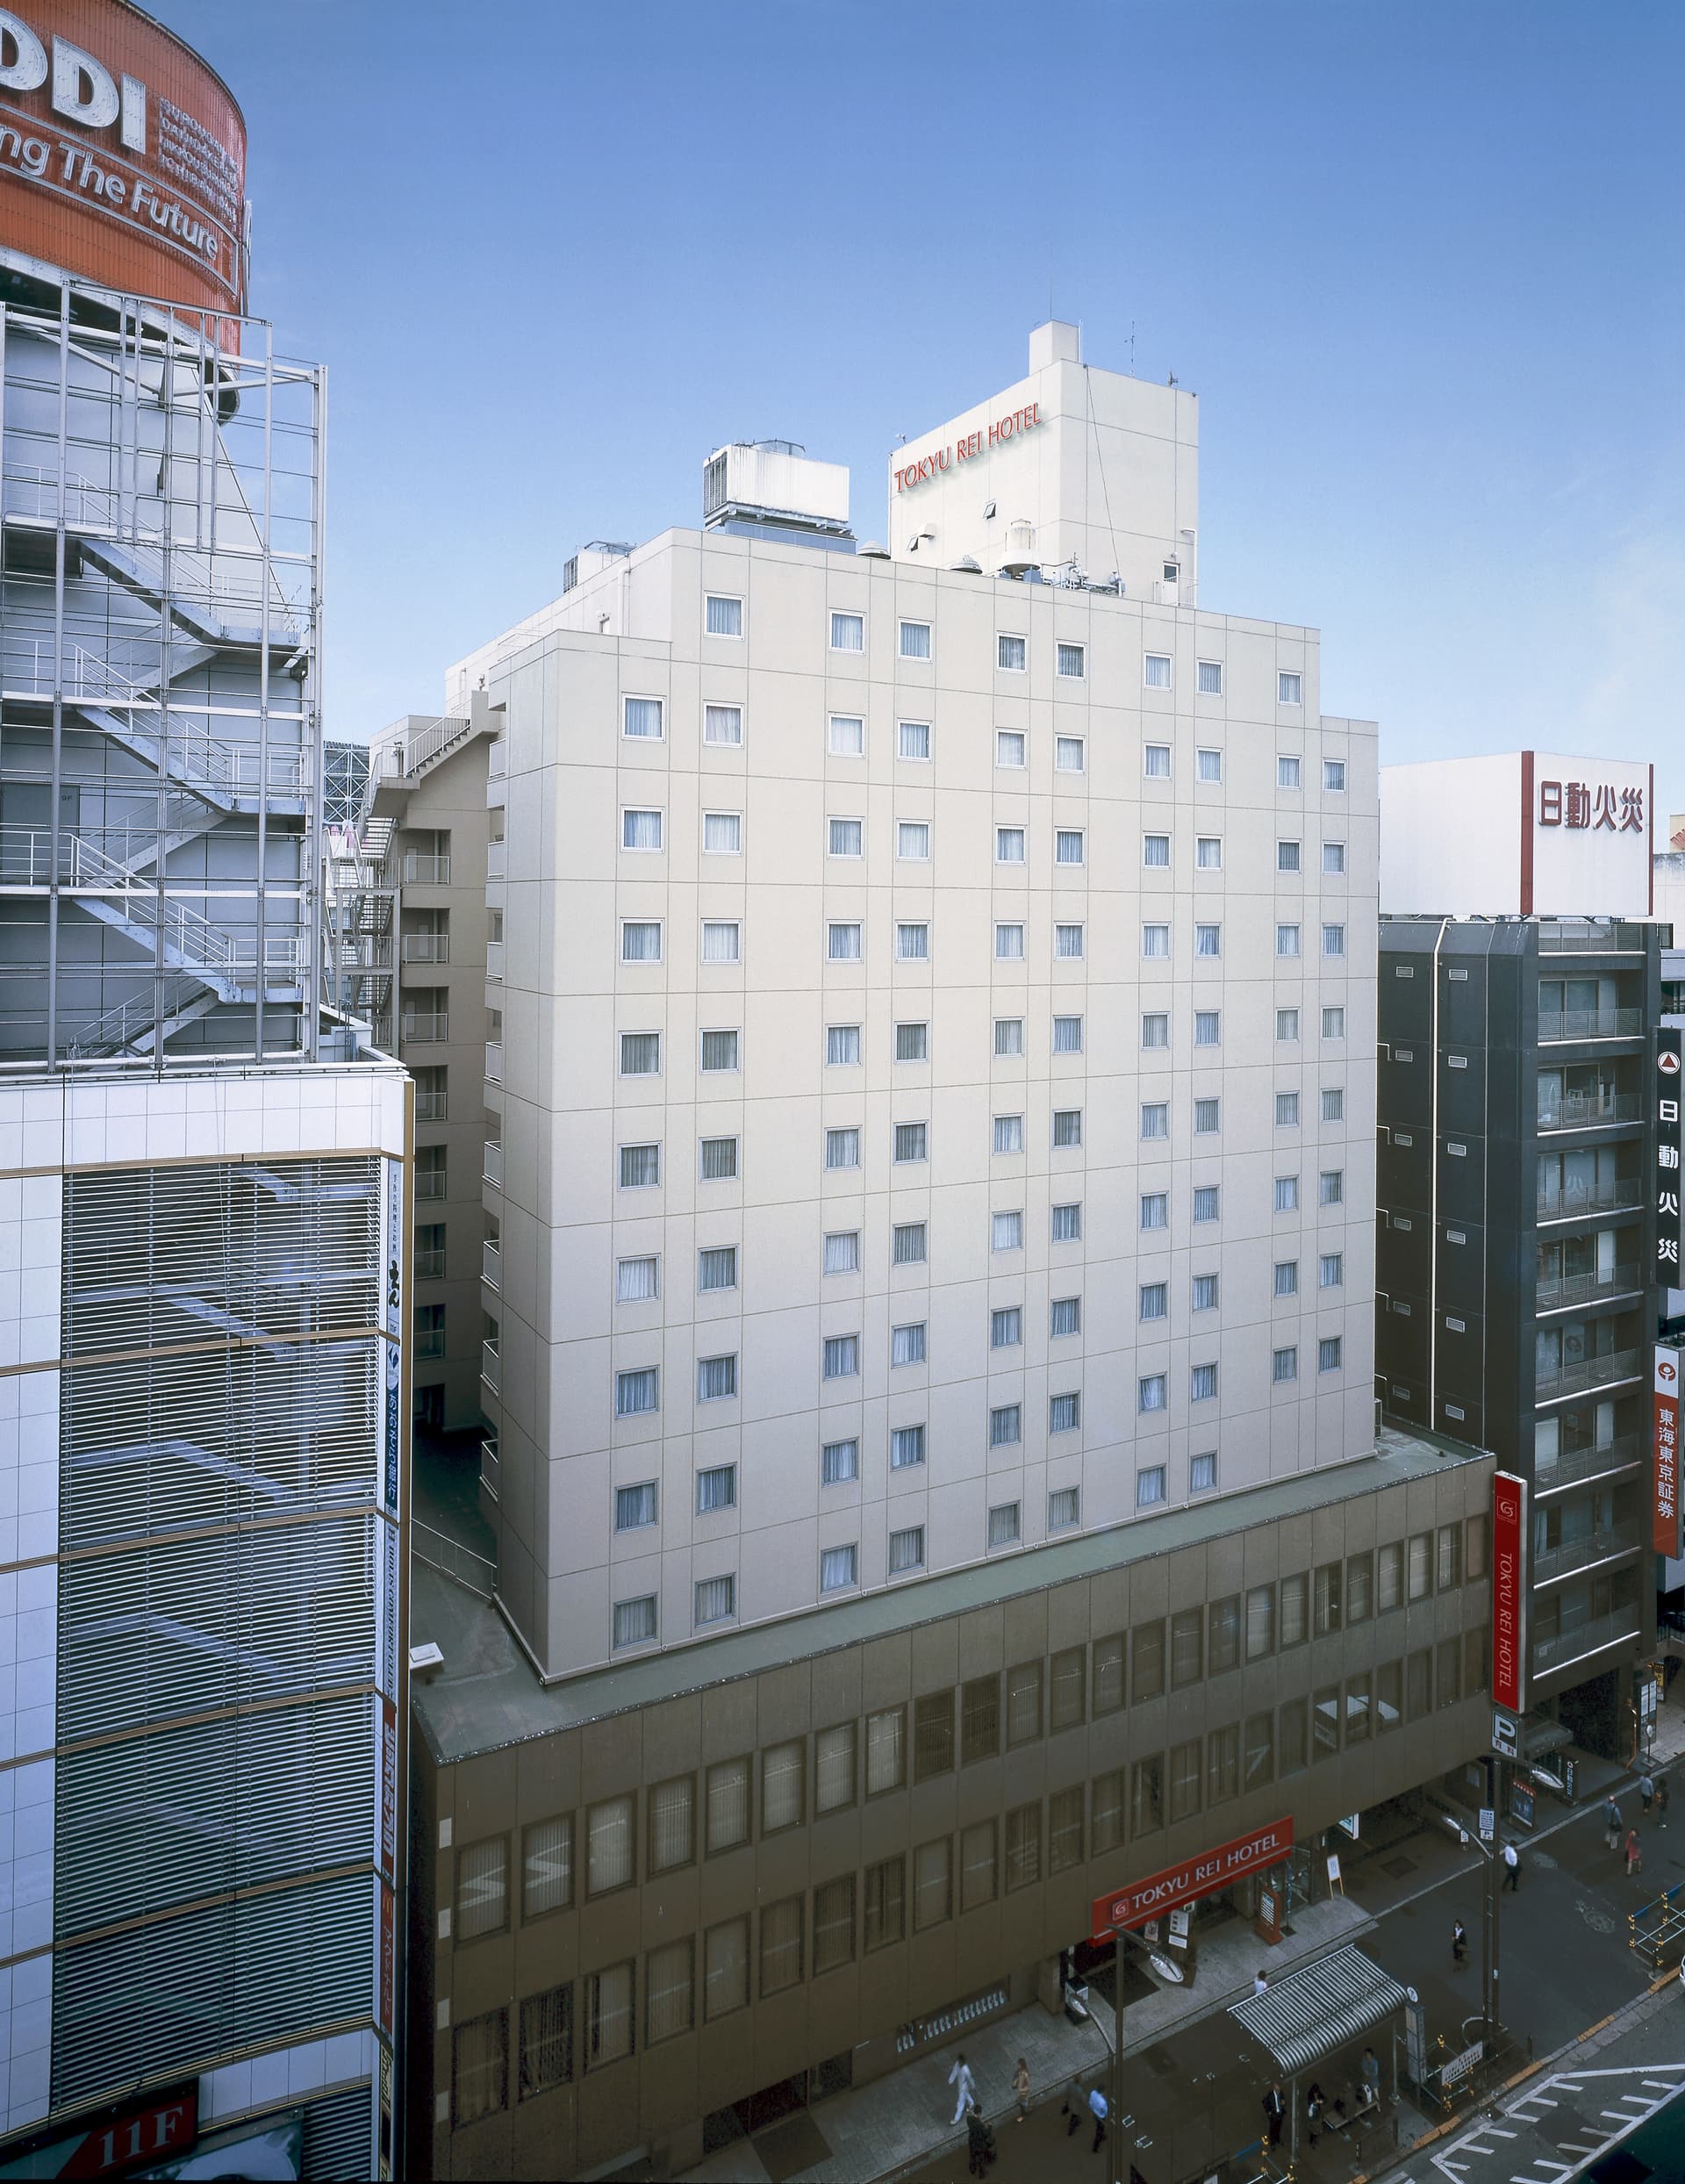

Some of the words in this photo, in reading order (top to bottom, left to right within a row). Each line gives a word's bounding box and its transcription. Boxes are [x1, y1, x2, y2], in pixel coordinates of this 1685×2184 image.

[59, 142, 126, 204] The
[131, 179, 219, 261] Future
[893, 446, 950, 492] TOKYU
[957, 431, 982, 463] REI
[988, 402, 1042, 447] HOTEL
[1539, 780, 1644, 833] 日動火災
[1658, 1100, 1678, 1264] 日動火災
[1657, 1408, 1674, 1519] 東海東京証券
[1500, 1552, 1512, 1606] TOKYU
[1500, 1608, 1511, 1634] REI
[1499, 1638, 1511, 1687] HOTEL
[1495, 1713, 1516, 1739] P
[1131, 1873, 1188, 1909] TOKYU
[1195, 1858, 1220, 1881] REI
[1227, 1834, 1279, 1868] HOTEL
[98, 2105, 183, 2170] 11F
